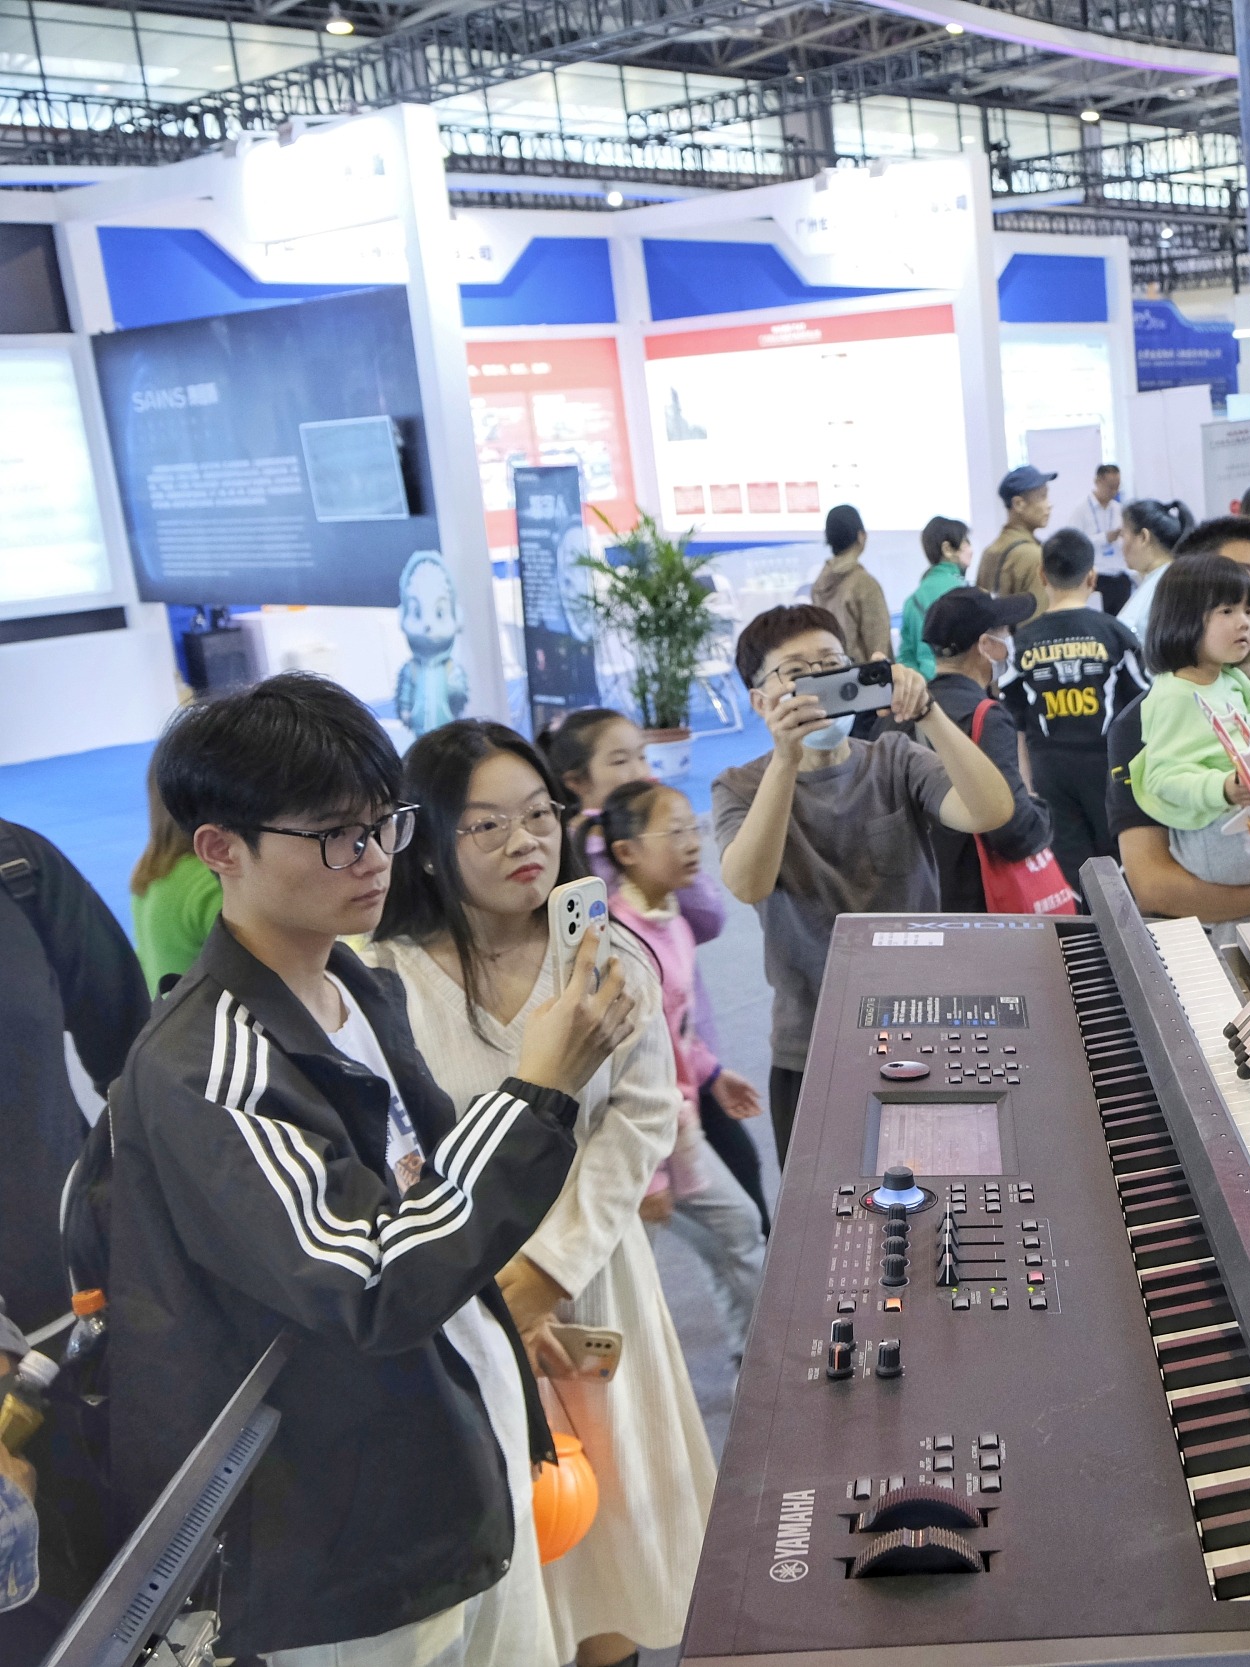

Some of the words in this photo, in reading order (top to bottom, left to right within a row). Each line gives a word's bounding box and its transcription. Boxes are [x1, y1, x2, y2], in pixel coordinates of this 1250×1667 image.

[132, 386, 187, 413] SAINS
[1021, 641, 1109, 671] CALIFORNIA
[1042, 686, 1099, 720] MOS
[774, 1489, 816, 1560] YAMAHA
